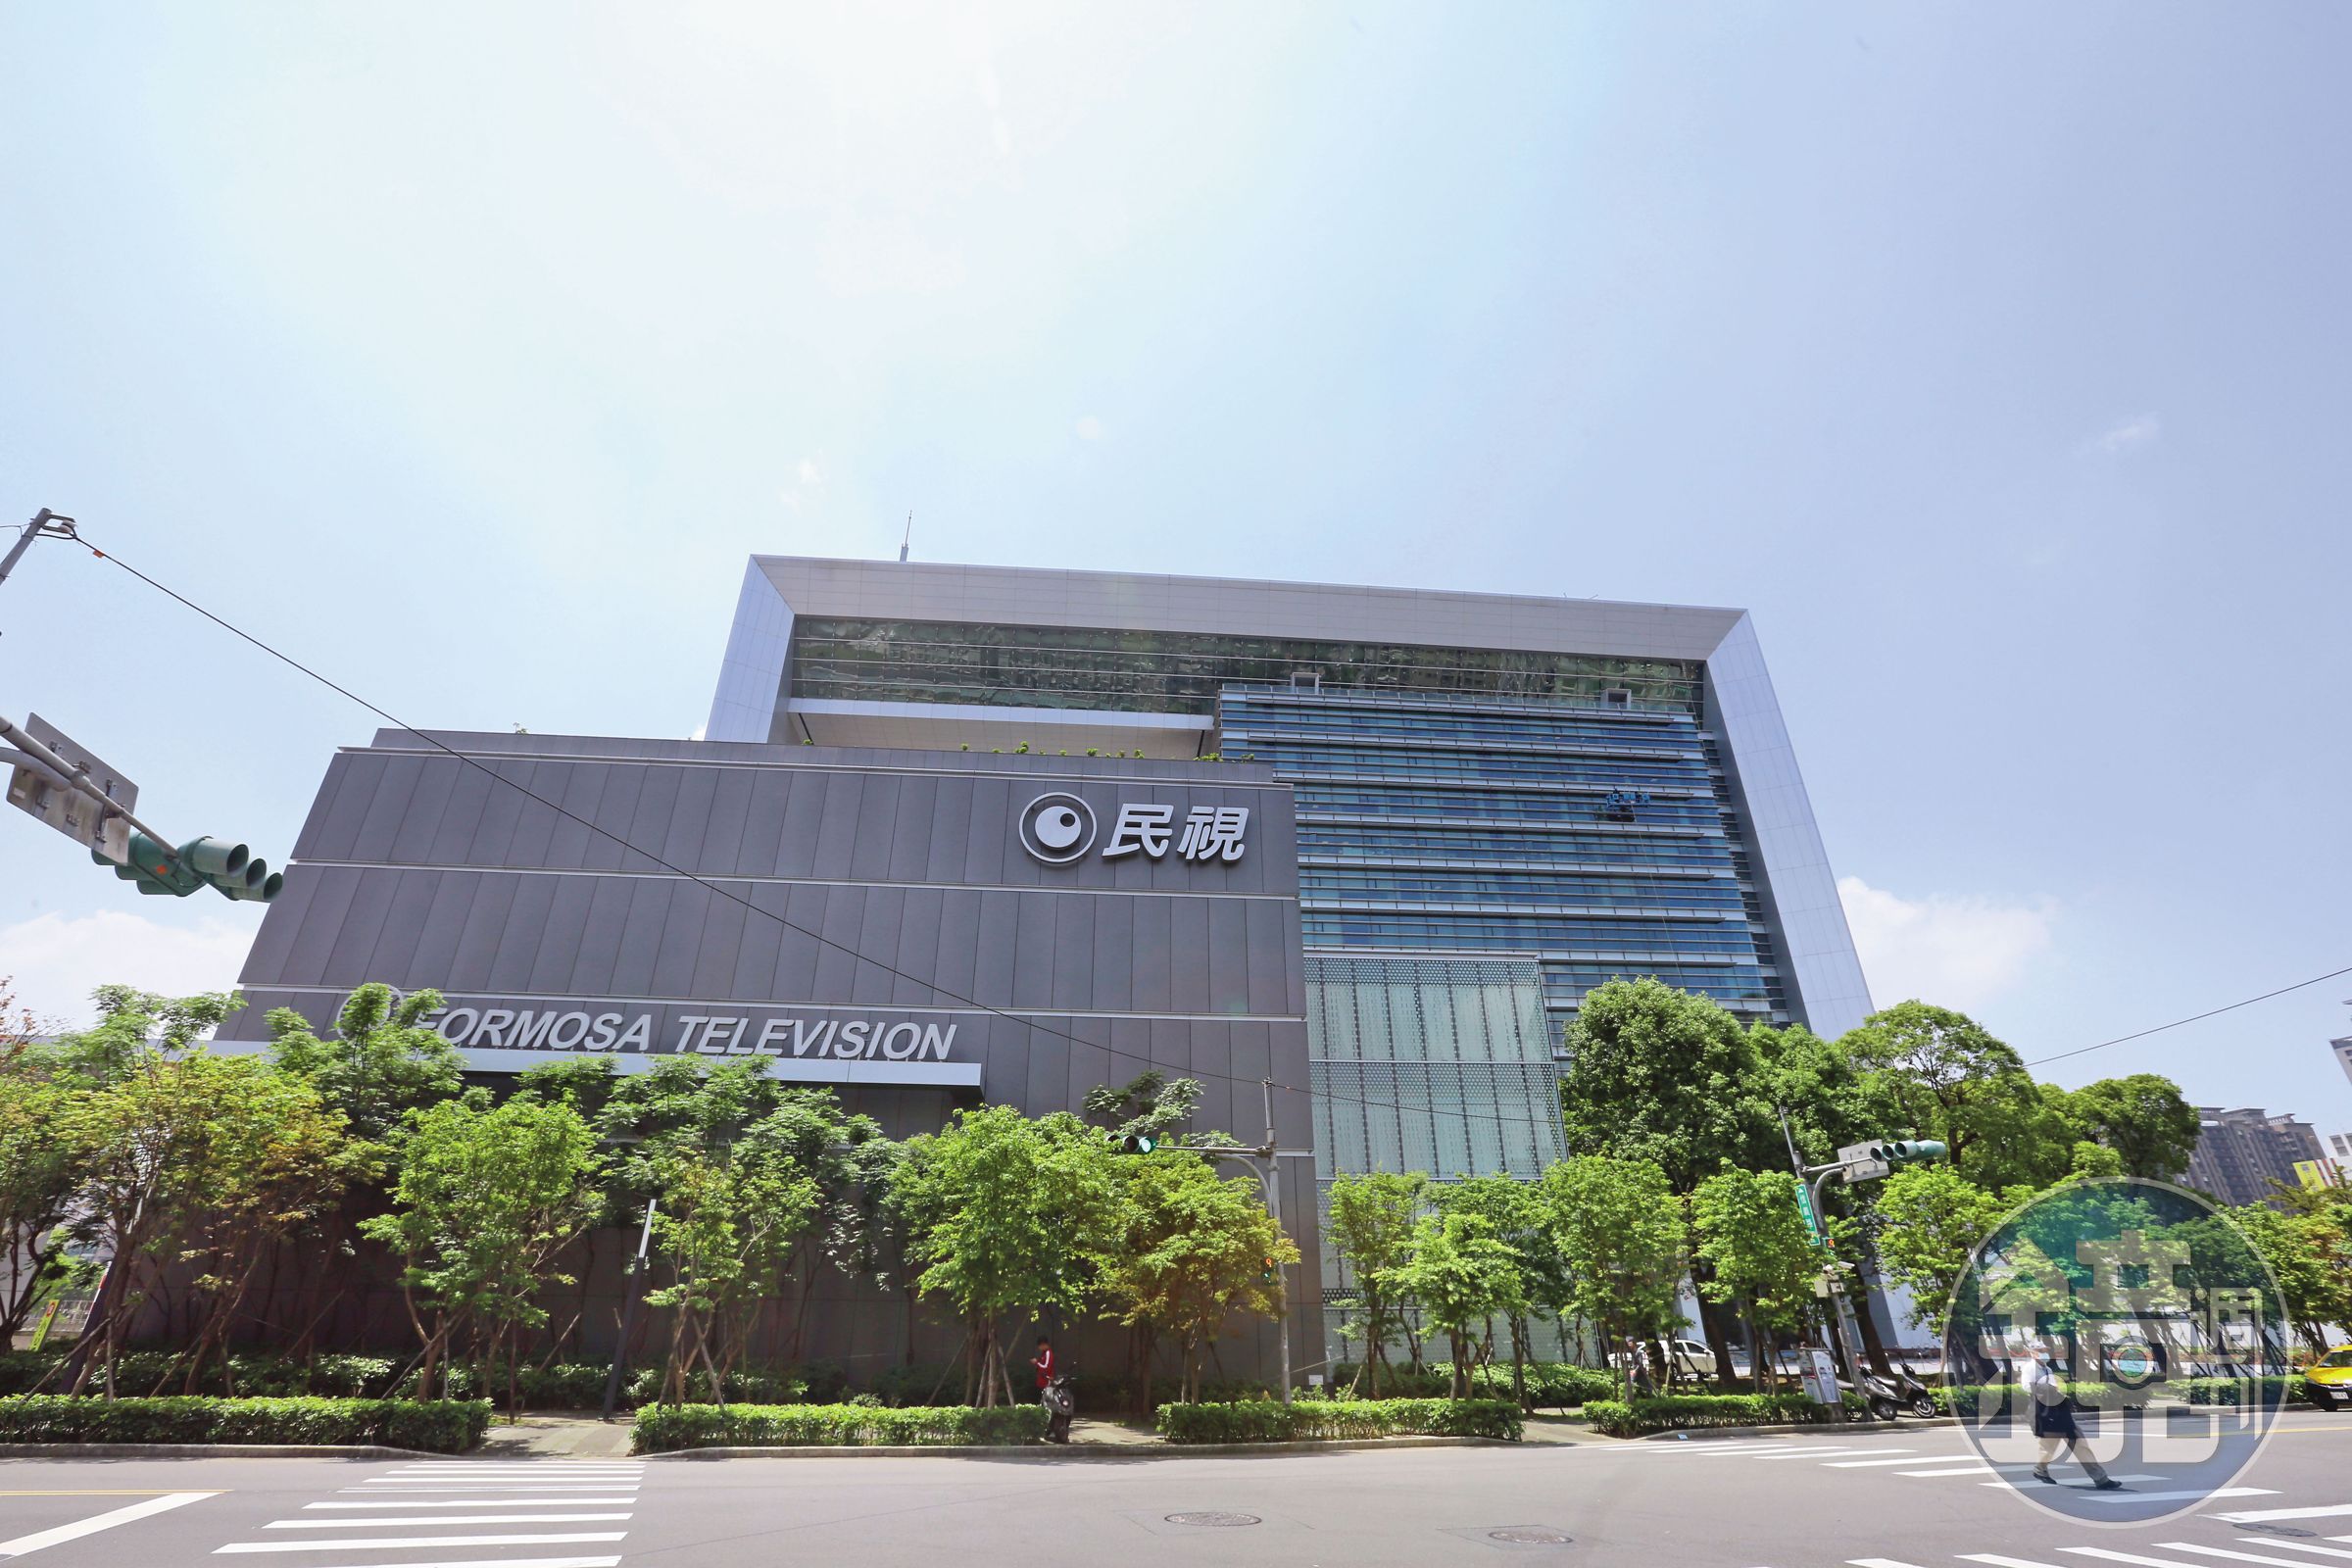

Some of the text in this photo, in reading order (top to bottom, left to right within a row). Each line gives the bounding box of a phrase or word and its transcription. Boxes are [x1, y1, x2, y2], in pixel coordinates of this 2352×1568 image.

[1102, 803, 1250, 860] 民視
[412, 1006, 957, 1061] FORMOSA TELEVISION
